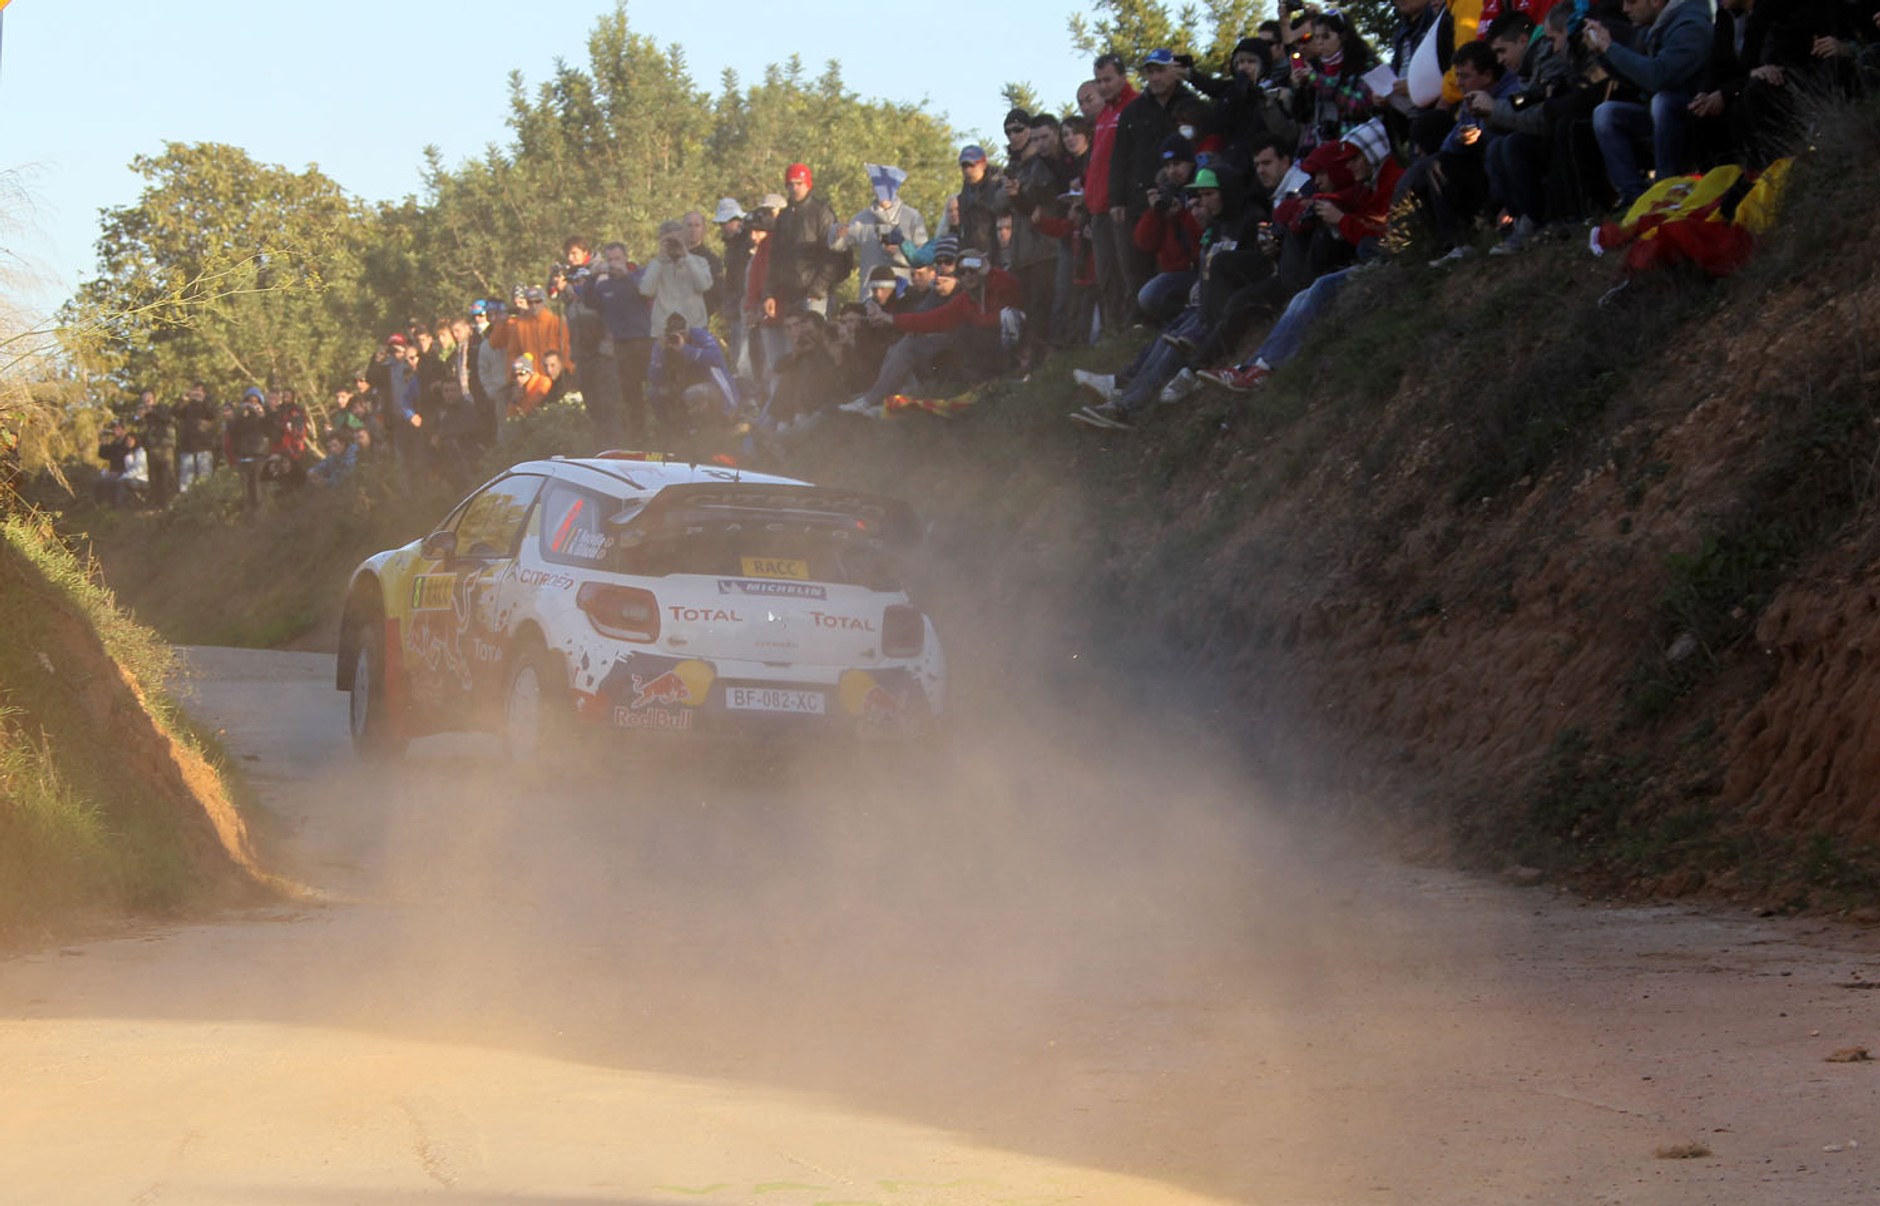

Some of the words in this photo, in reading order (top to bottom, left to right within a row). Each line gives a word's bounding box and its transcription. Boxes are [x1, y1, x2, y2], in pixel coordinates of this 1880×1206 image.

[752, 561, 798, 576] RACC
[745, 582, 824, 597] MICHELIN
[668, 606, 743, 622] TOTAL
[810, 611, 876, 632] TOTAL
